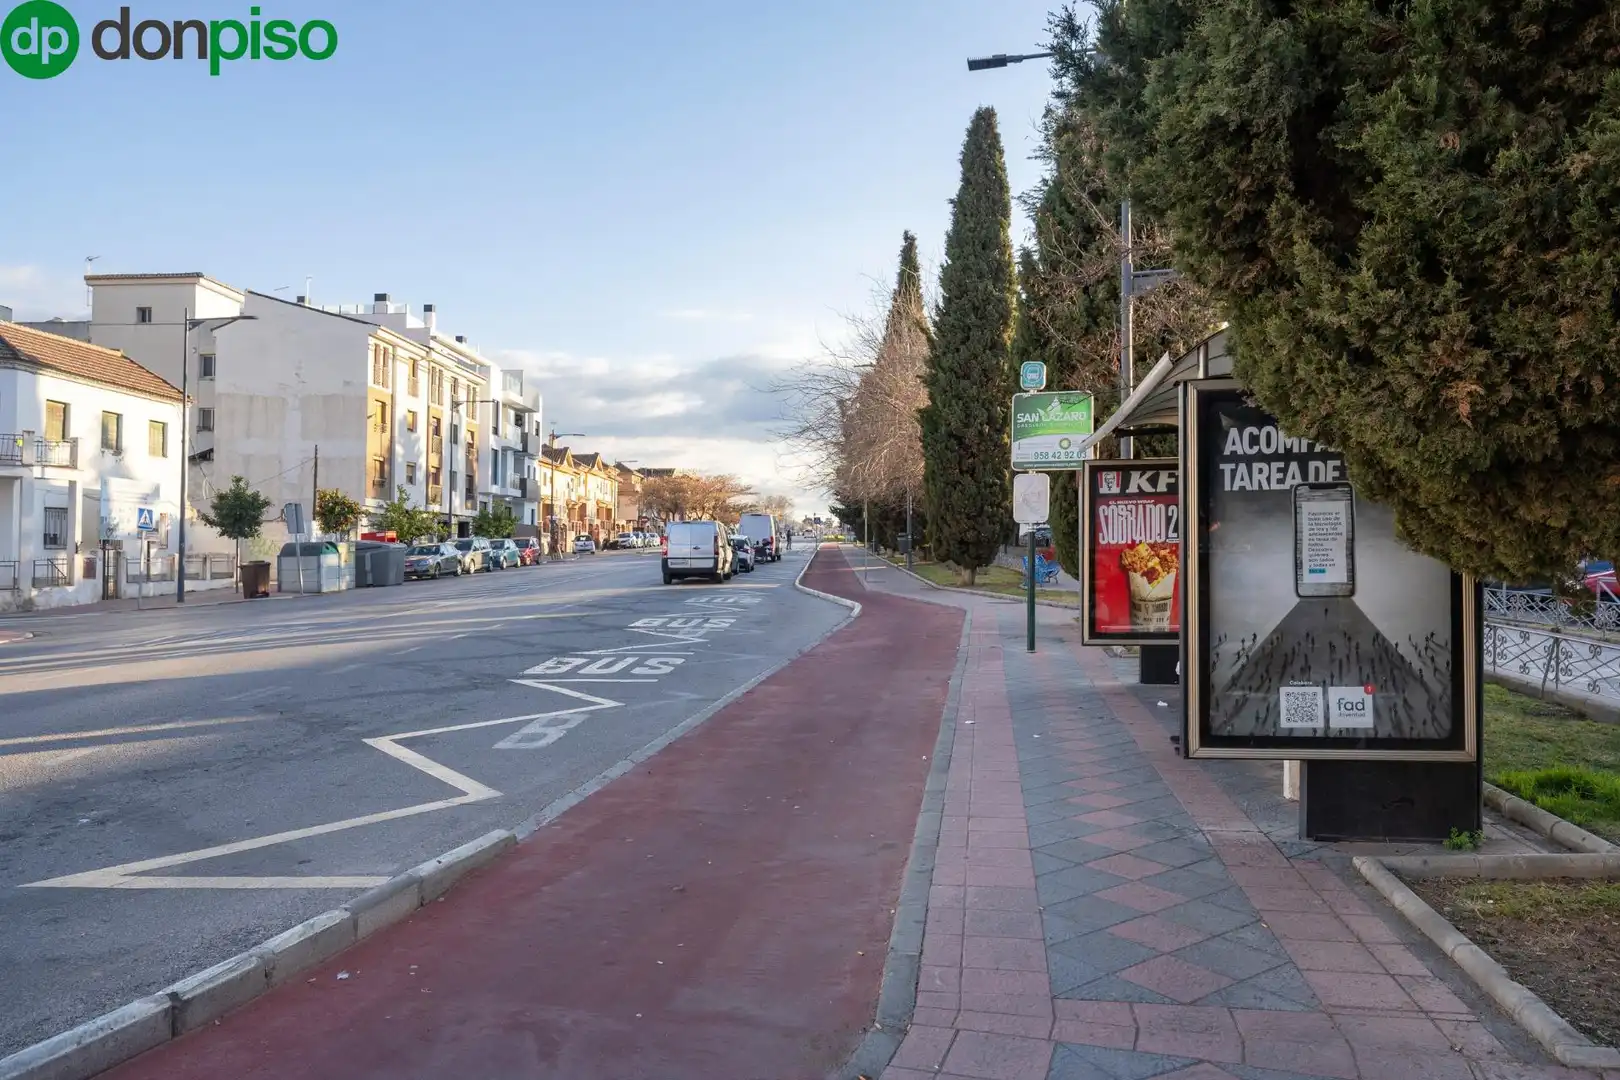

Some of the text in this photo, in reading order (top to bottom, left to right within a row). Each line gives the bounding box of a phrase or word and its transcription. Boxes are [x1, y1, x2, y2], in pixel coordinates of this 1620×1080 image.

[1016, 413, 1039, 423] SAN
[1223, 426, 1339, 456] ACOM
[1033, 451, 1049, 460] 958
[1051, 451, 1062, 460] 42
[1064, 451, 1075, 459] 92
[1125, 470, 1179, 493] KF
[1219, 459, 1342, 491] TAREA DE
[628, 618, 737, 628] BUS
[520, 657, 687, 675] BUS
[1336, 698, 1366, 712] fad
